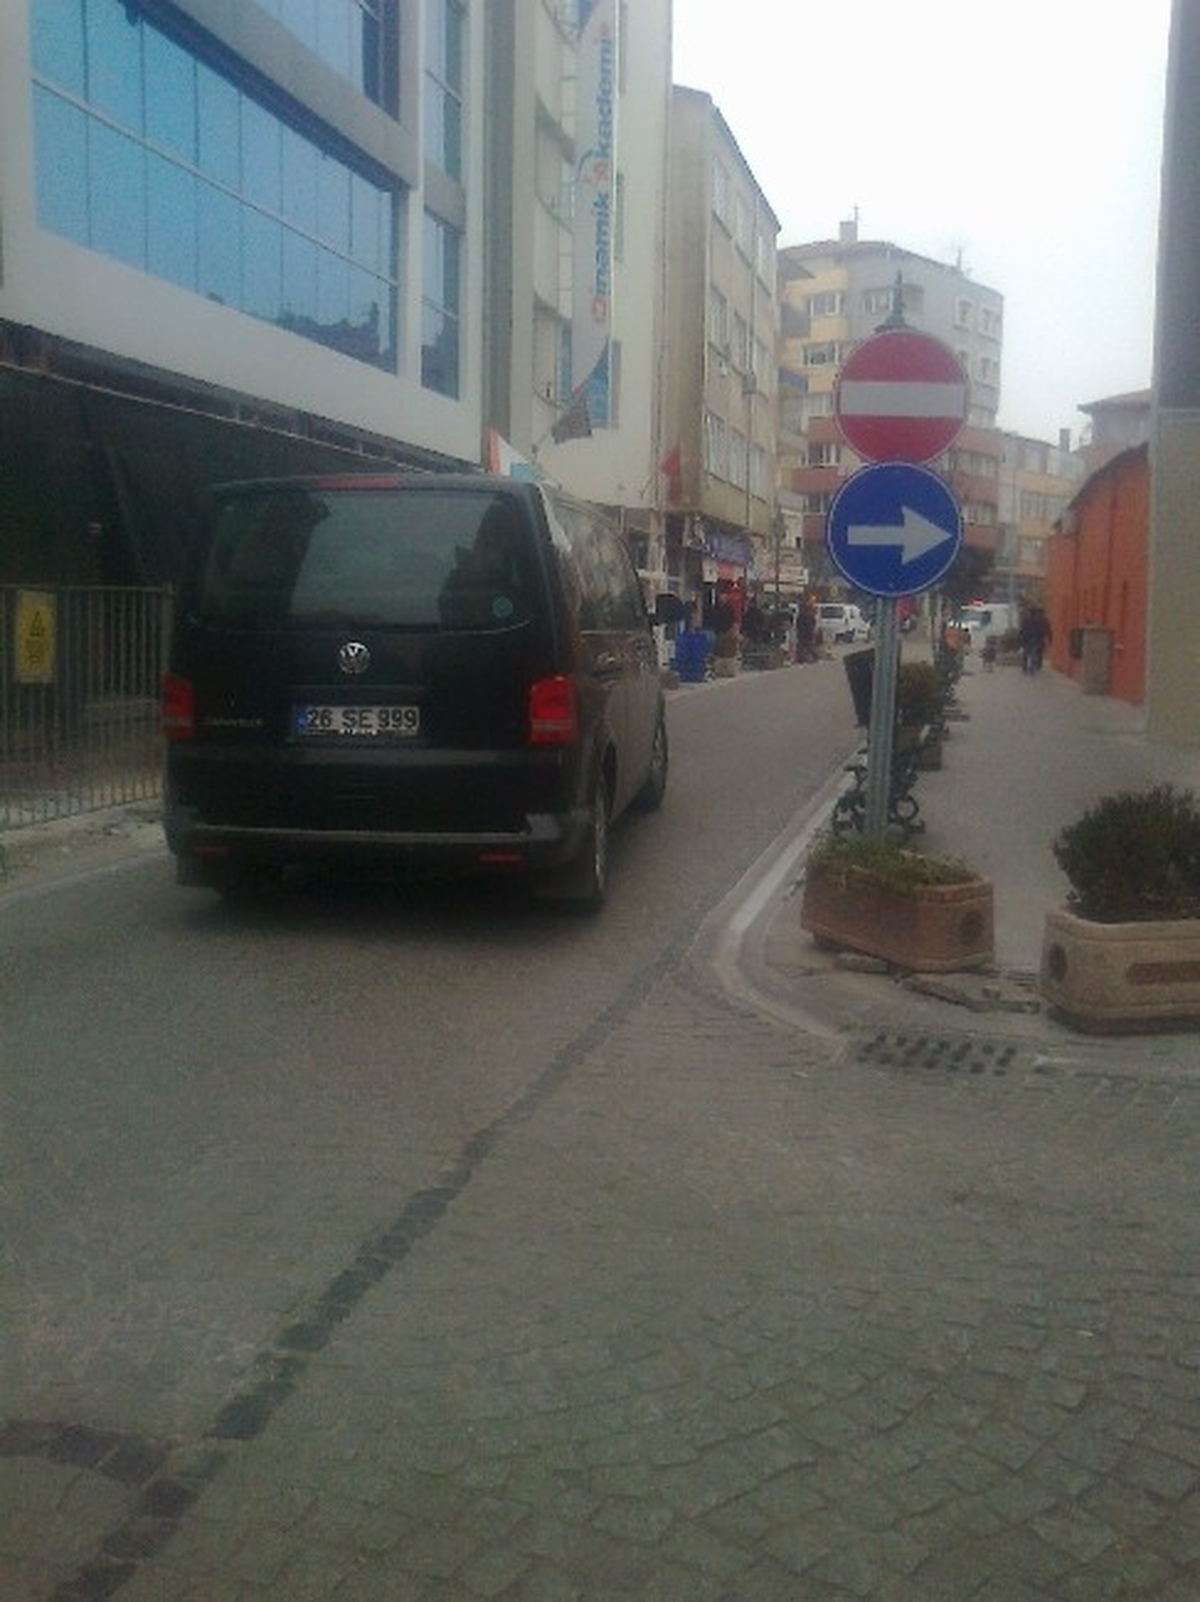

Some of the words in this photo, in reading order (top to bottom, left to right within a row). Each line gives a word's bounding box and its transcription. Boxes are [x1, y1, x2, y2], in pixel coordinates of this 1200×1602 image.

[307, 708, 333, 728] 26
[341, 708, 375, 729] SE
[378, 708, 418, 729] 999
